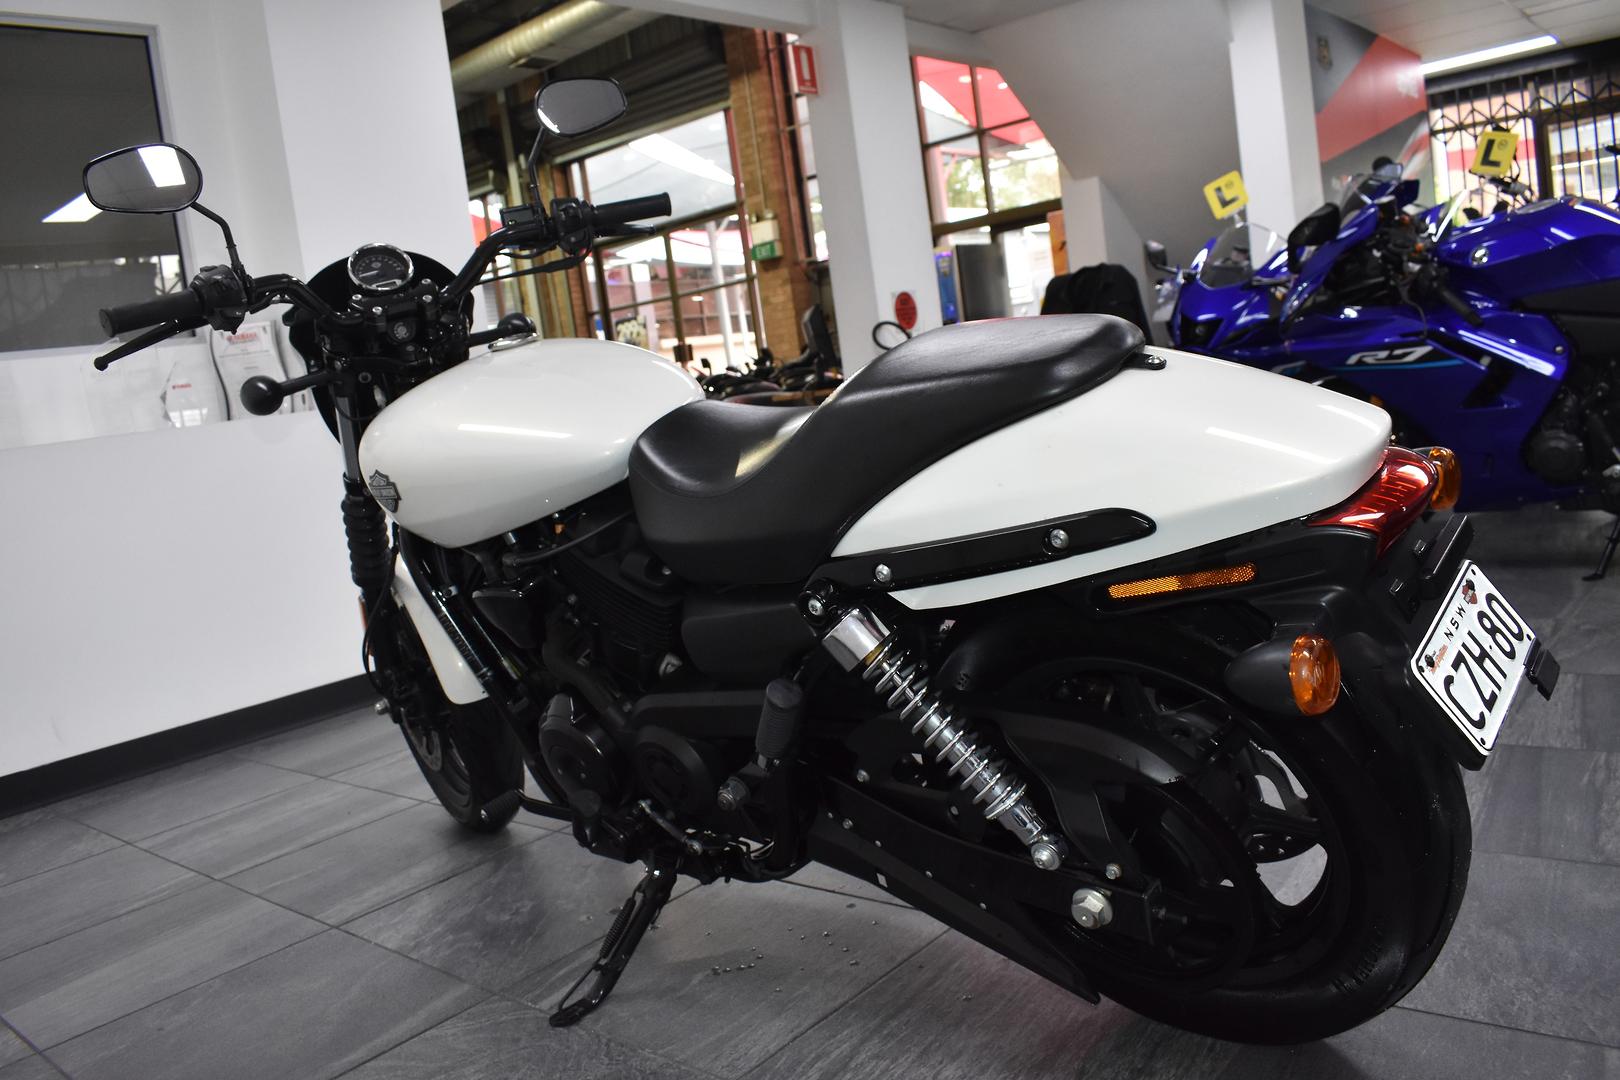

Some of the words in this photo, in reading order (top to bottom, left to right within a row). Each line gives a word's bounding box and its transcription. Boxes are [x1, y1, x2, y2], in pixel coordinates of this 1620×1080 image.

[1480, 139, 1502, 167] L
[1214, 186, 1240, 208] L
[1345, 345, 1434, 365] R7
[1443, 603, 1466, 641] NSW
